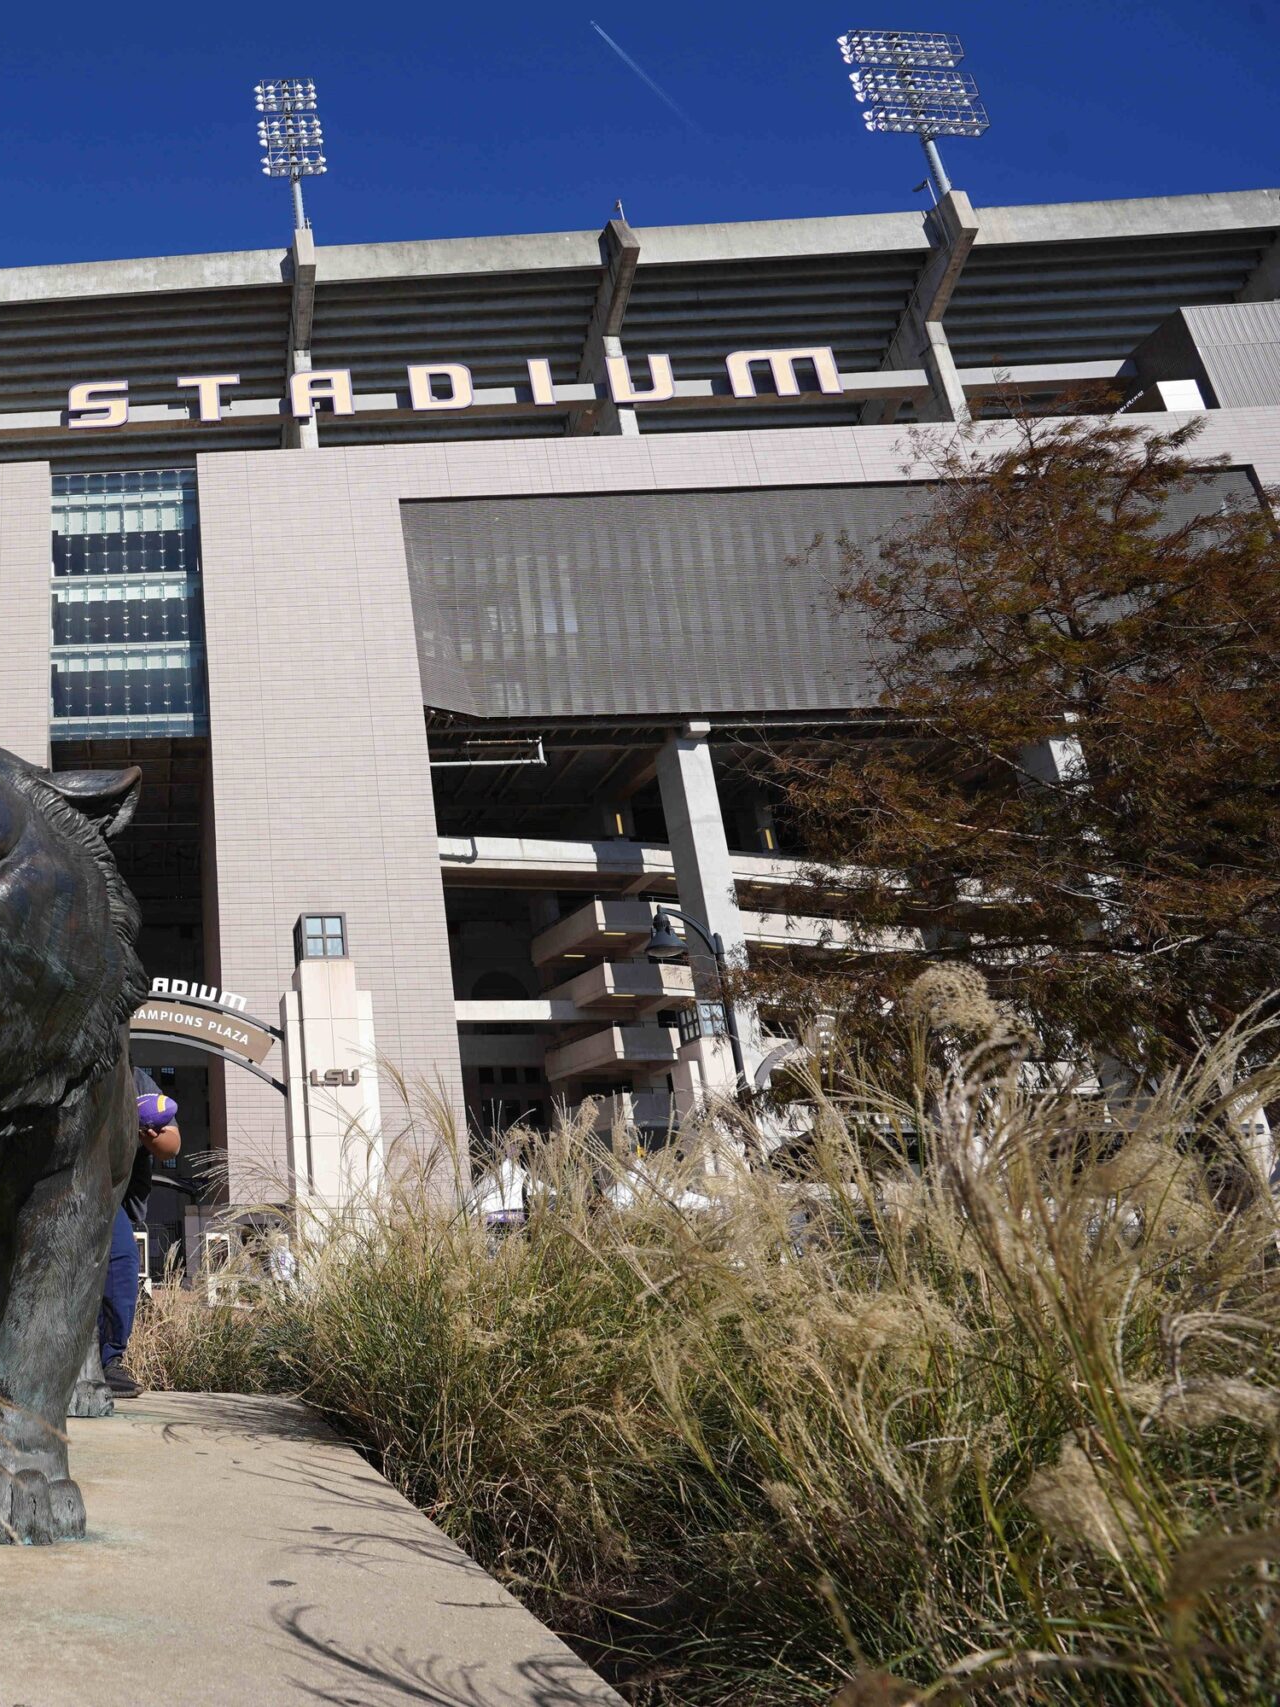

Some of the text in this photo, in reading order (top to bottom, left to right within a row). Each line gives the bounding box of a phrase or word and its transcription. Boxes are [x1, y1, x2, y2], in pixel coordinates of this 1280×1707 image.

[67, 346, 844, 431] STADIUM
[152, 977, 247, 1012] ADIUM
[133, 1009, 249, 1045] AMPIONS PLAZA
[309, 1068, 360, 1087] LSU
